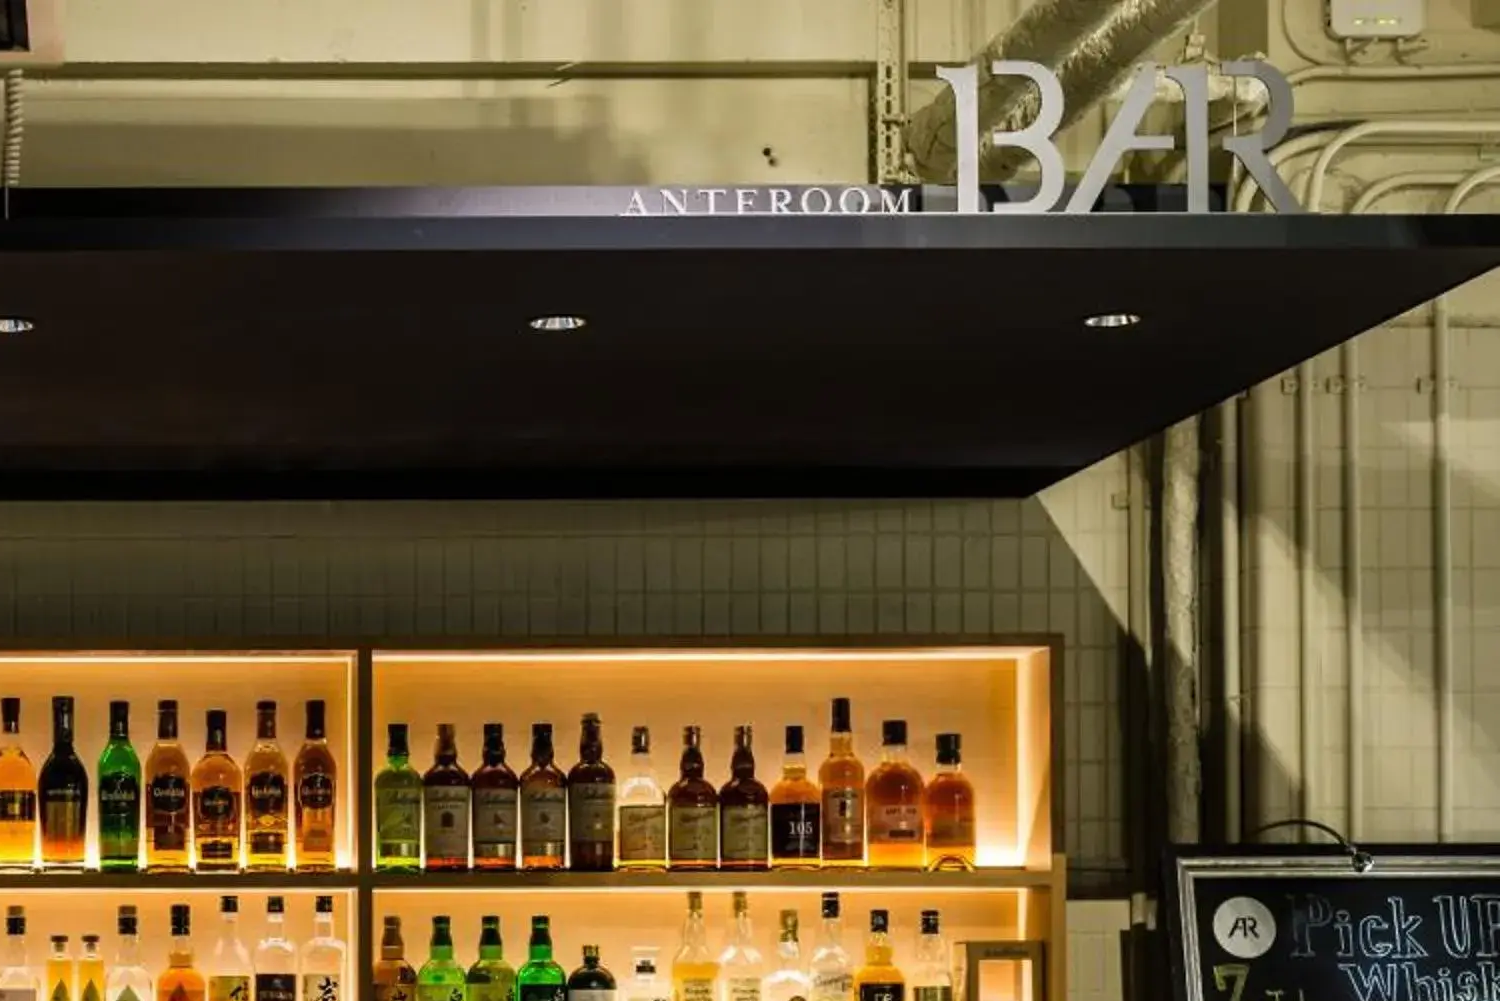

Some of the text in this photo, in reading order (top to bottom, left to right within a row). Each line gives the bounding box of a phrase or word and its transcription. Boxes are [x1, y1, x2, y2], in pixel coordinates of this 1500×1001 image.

[935, 59, 1307, 214] BAR
[621, 187, 912, 215] ANTEROOM
[789, 821, 813, 835] 105
[1286, 894, 1429, 958] Pick
